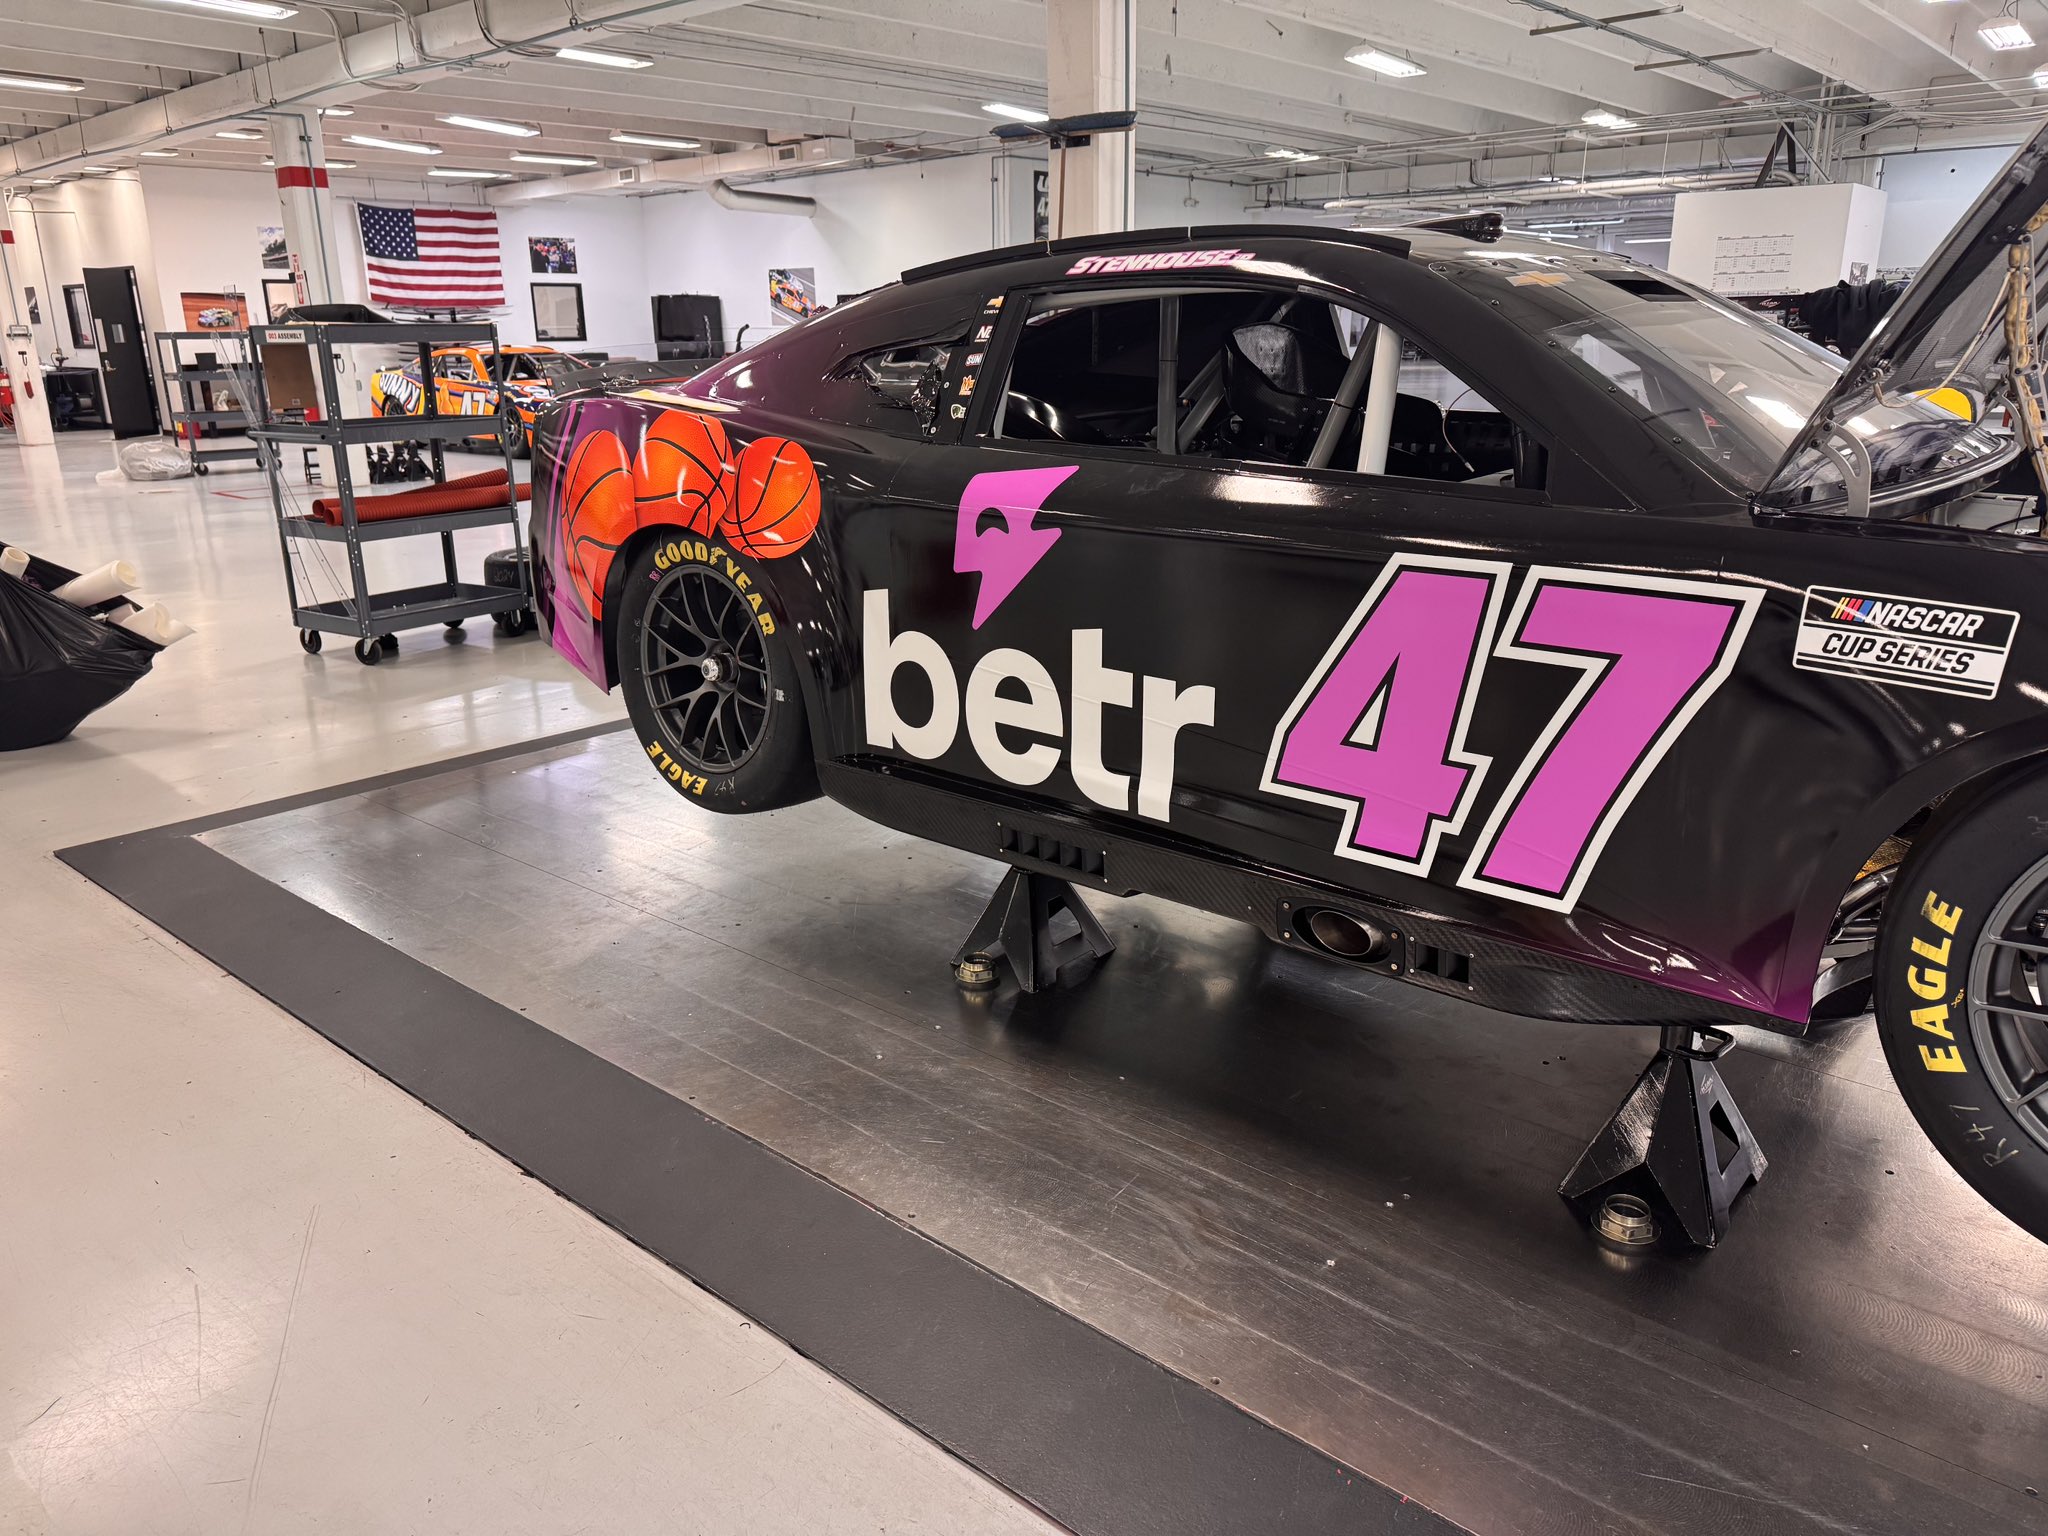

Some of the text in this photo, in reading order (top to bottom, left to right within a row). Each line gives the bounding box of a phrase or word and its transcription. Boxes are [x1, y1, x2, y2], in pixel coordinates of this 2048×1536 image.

[1065, 249, 1241, 275] STENHOUSE
[277, 332, 302, 340] ASSEMBLY
[460, 391, 487, 416] 47
[654, 540, 776, 637] GOODYEAR
[1864, 601, 1984, 639] NASCAR
[1821, 632, 1975, 675] CUP SERIES
[863, 589, 1215, 822] betr
[1259, 552, 1767, 914] 47
[646, 740, 709, 796] EAGLE
[1907, 890, 1968, 1073] EAGLE
